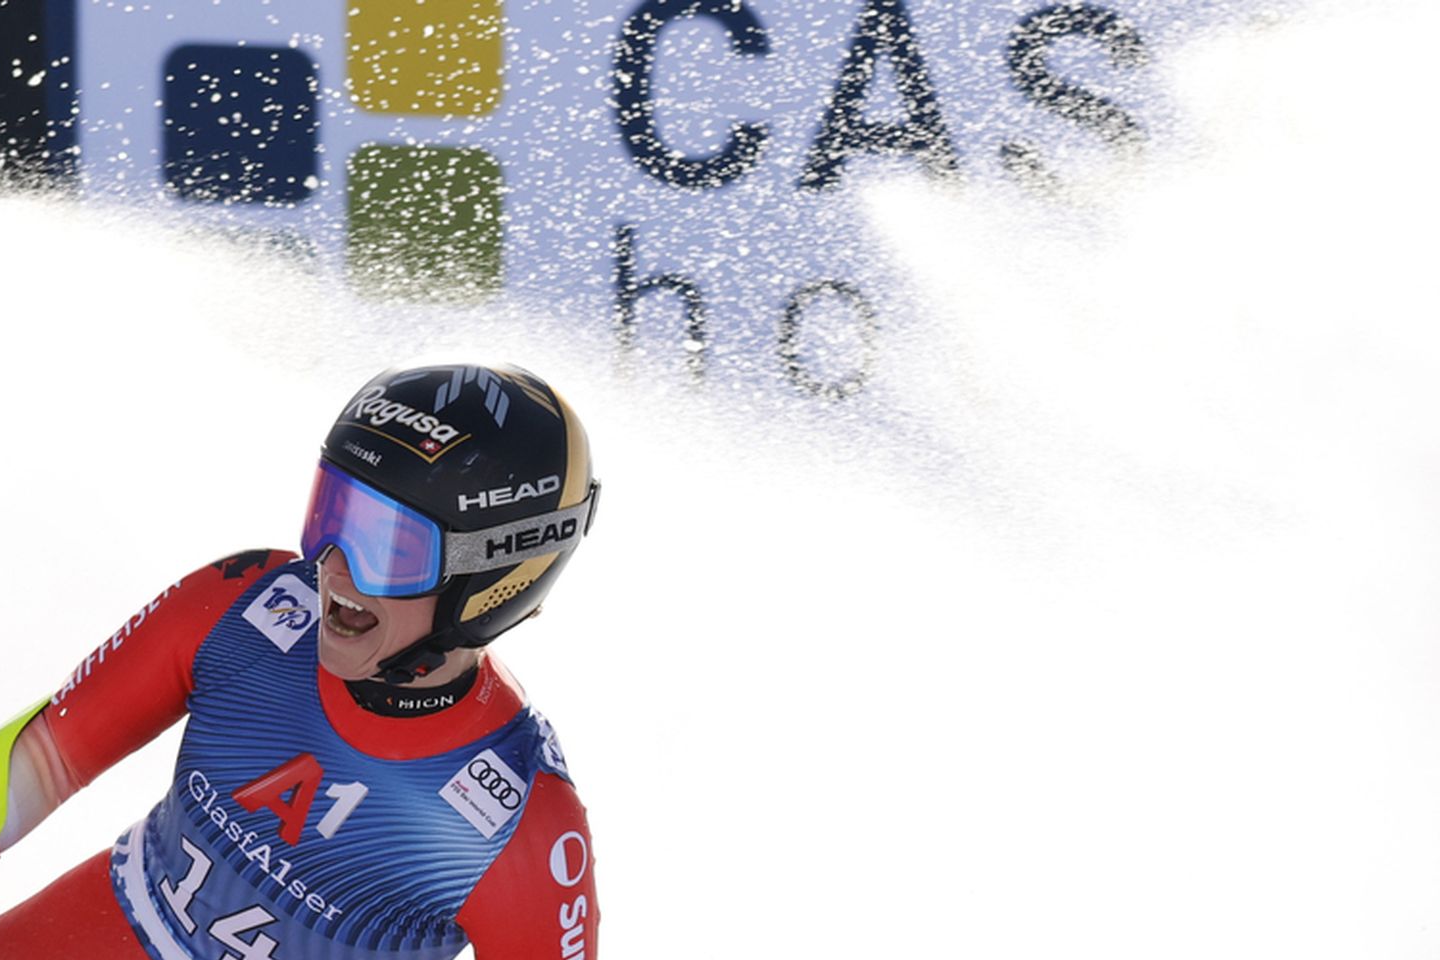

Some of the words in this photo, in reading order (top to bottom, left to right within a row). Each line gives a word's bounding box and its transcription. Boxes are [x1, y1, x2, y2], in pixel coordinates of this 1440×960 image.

[345, 384, 459, 444] Ragusa
[458, 475, 560, 512] HEAD
[485, 517, 578, 560] HEAD
[231, 752, 369, 847] A1
[187, 770, 343, 921] GlasfA1ser
